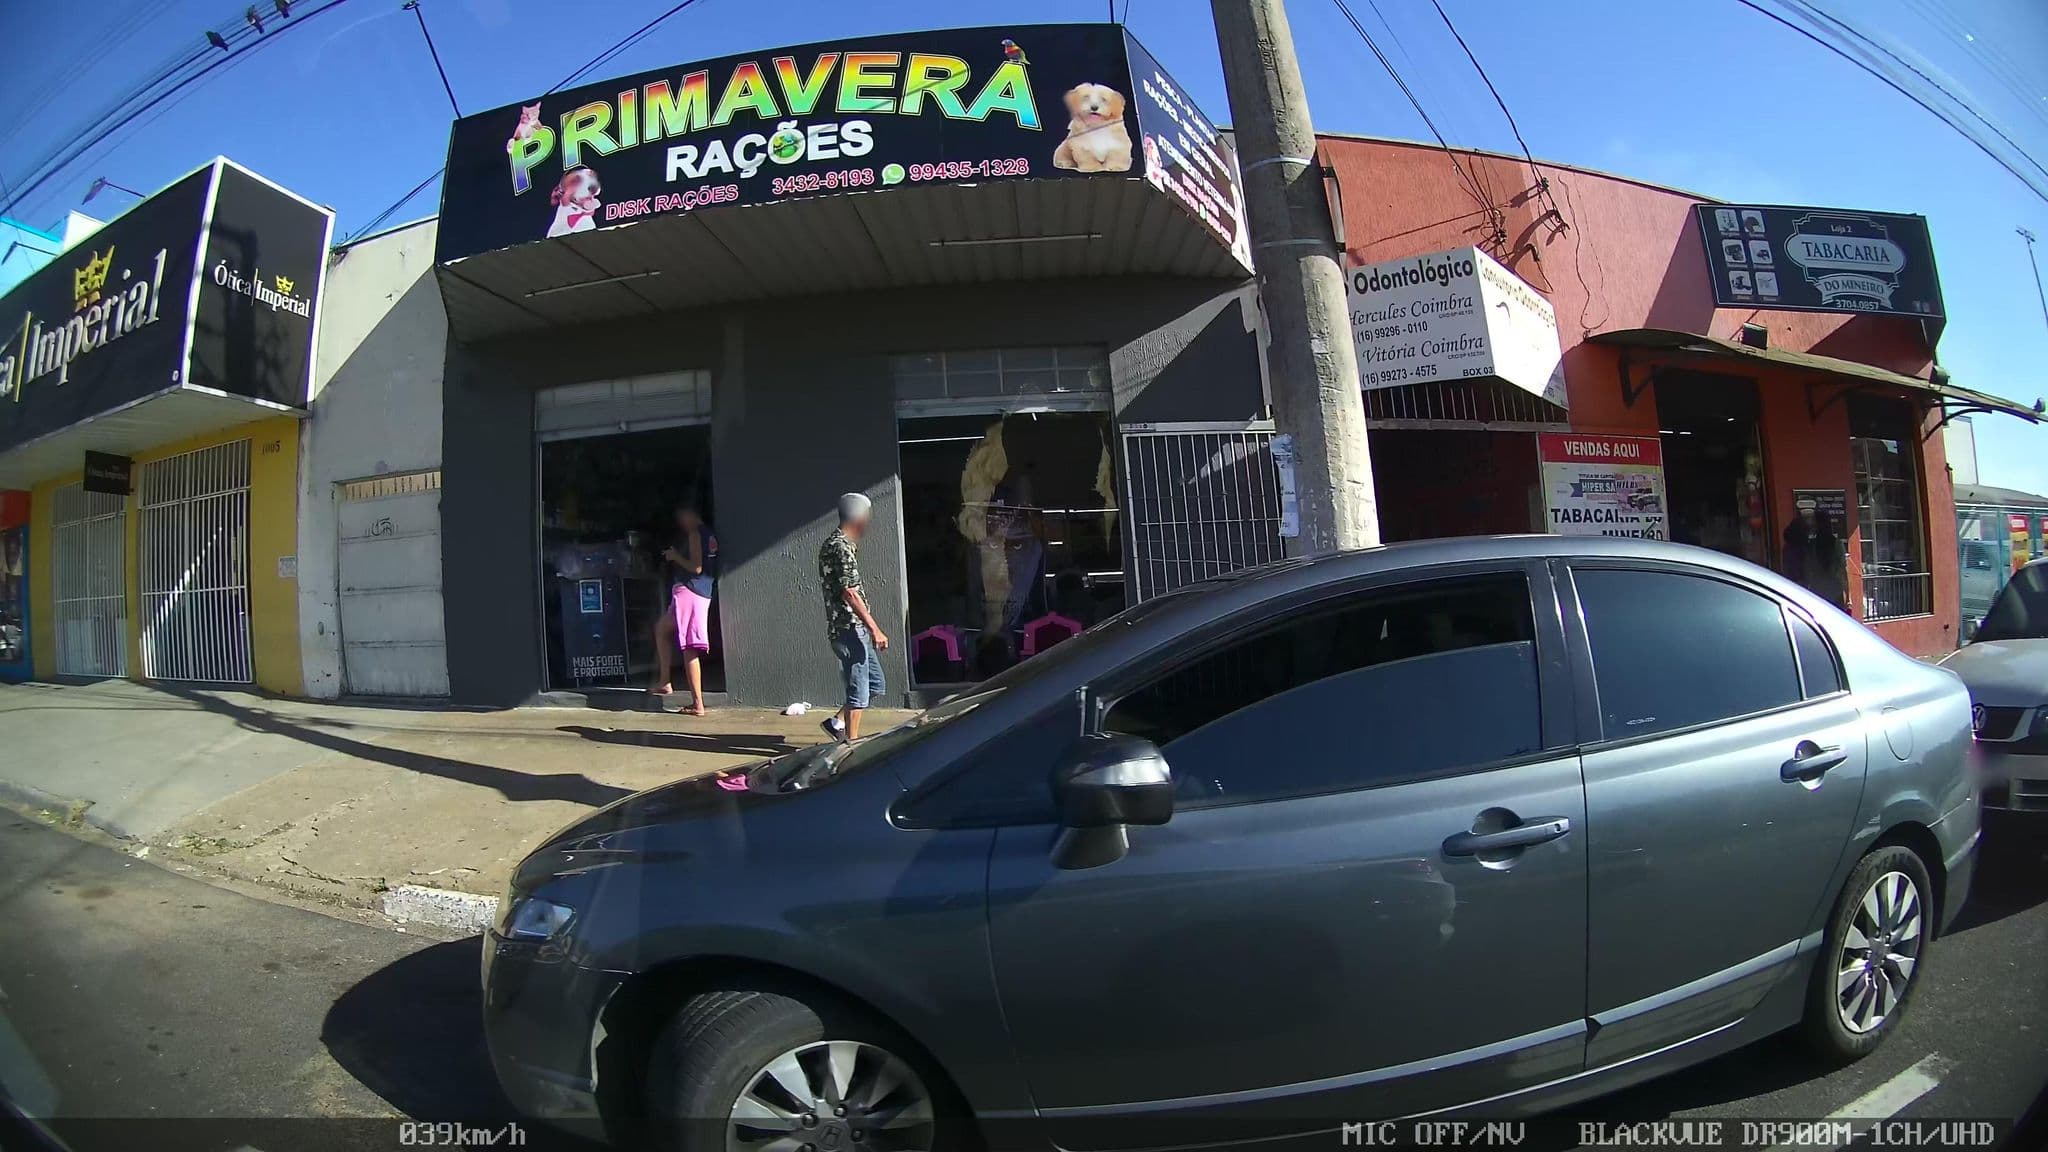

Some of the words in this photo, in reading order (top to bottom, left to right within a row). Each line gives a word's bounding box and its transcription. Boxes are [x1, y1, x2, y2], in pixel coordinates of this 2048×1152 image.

[508, 50, 1042, 196] PRIMAVERA
[665, 119, 874, 182] RAÇÕES
[772, 168, 875, 195] 3432-8193
[908, 157, 1029, 182] 99435-1328
[605, 197, 651, 221] DISK
[655, 184, 739, 211] RAÇÕES
[1830, 225, 1846, 234] Loja
[1845, 225, 1853, 233] 2
[1801, 241, 1890, 262] TABACARIA
[1354, 255, 1474, 294] Odontológico
[214, 259, 252, 297] Ótica
[255, 279, 311, 318] Imperial
[1824, 281, 1839, 292] DO
[1841, 280, 1884, 295] MINEIRO
[26, 248, 168, 386] Imperial
[1411, 293, 1473, 317] Coimbra
[1357, 330, 1374, 344] (16)
[1374, 325, 1400, 340] 99296
[1407, 320, 1428, 334] 0110
[1362, 342, 1416, 364] Vitória
[1421, 333, 1484, 358] Coimbra
[1362, 371, 1379, 386] (16)
[1380, 368, 1408, 382] 99273
[1415, 364, 1437, 378] 4575
[1463, 368, 1482, 376] BOX
[1483, 366, 1493, 375] 03
[1563, 441, 1610, 457] VENDAS
[1613, 443, 1640, 457] AQUI
[1581, 481, 1603, 492] HIPER
[572, 655, 595, 668] MAIS
[596, 655, 624, 667] FORTE
[580, 665, 625, 677] PROTEGIDO
